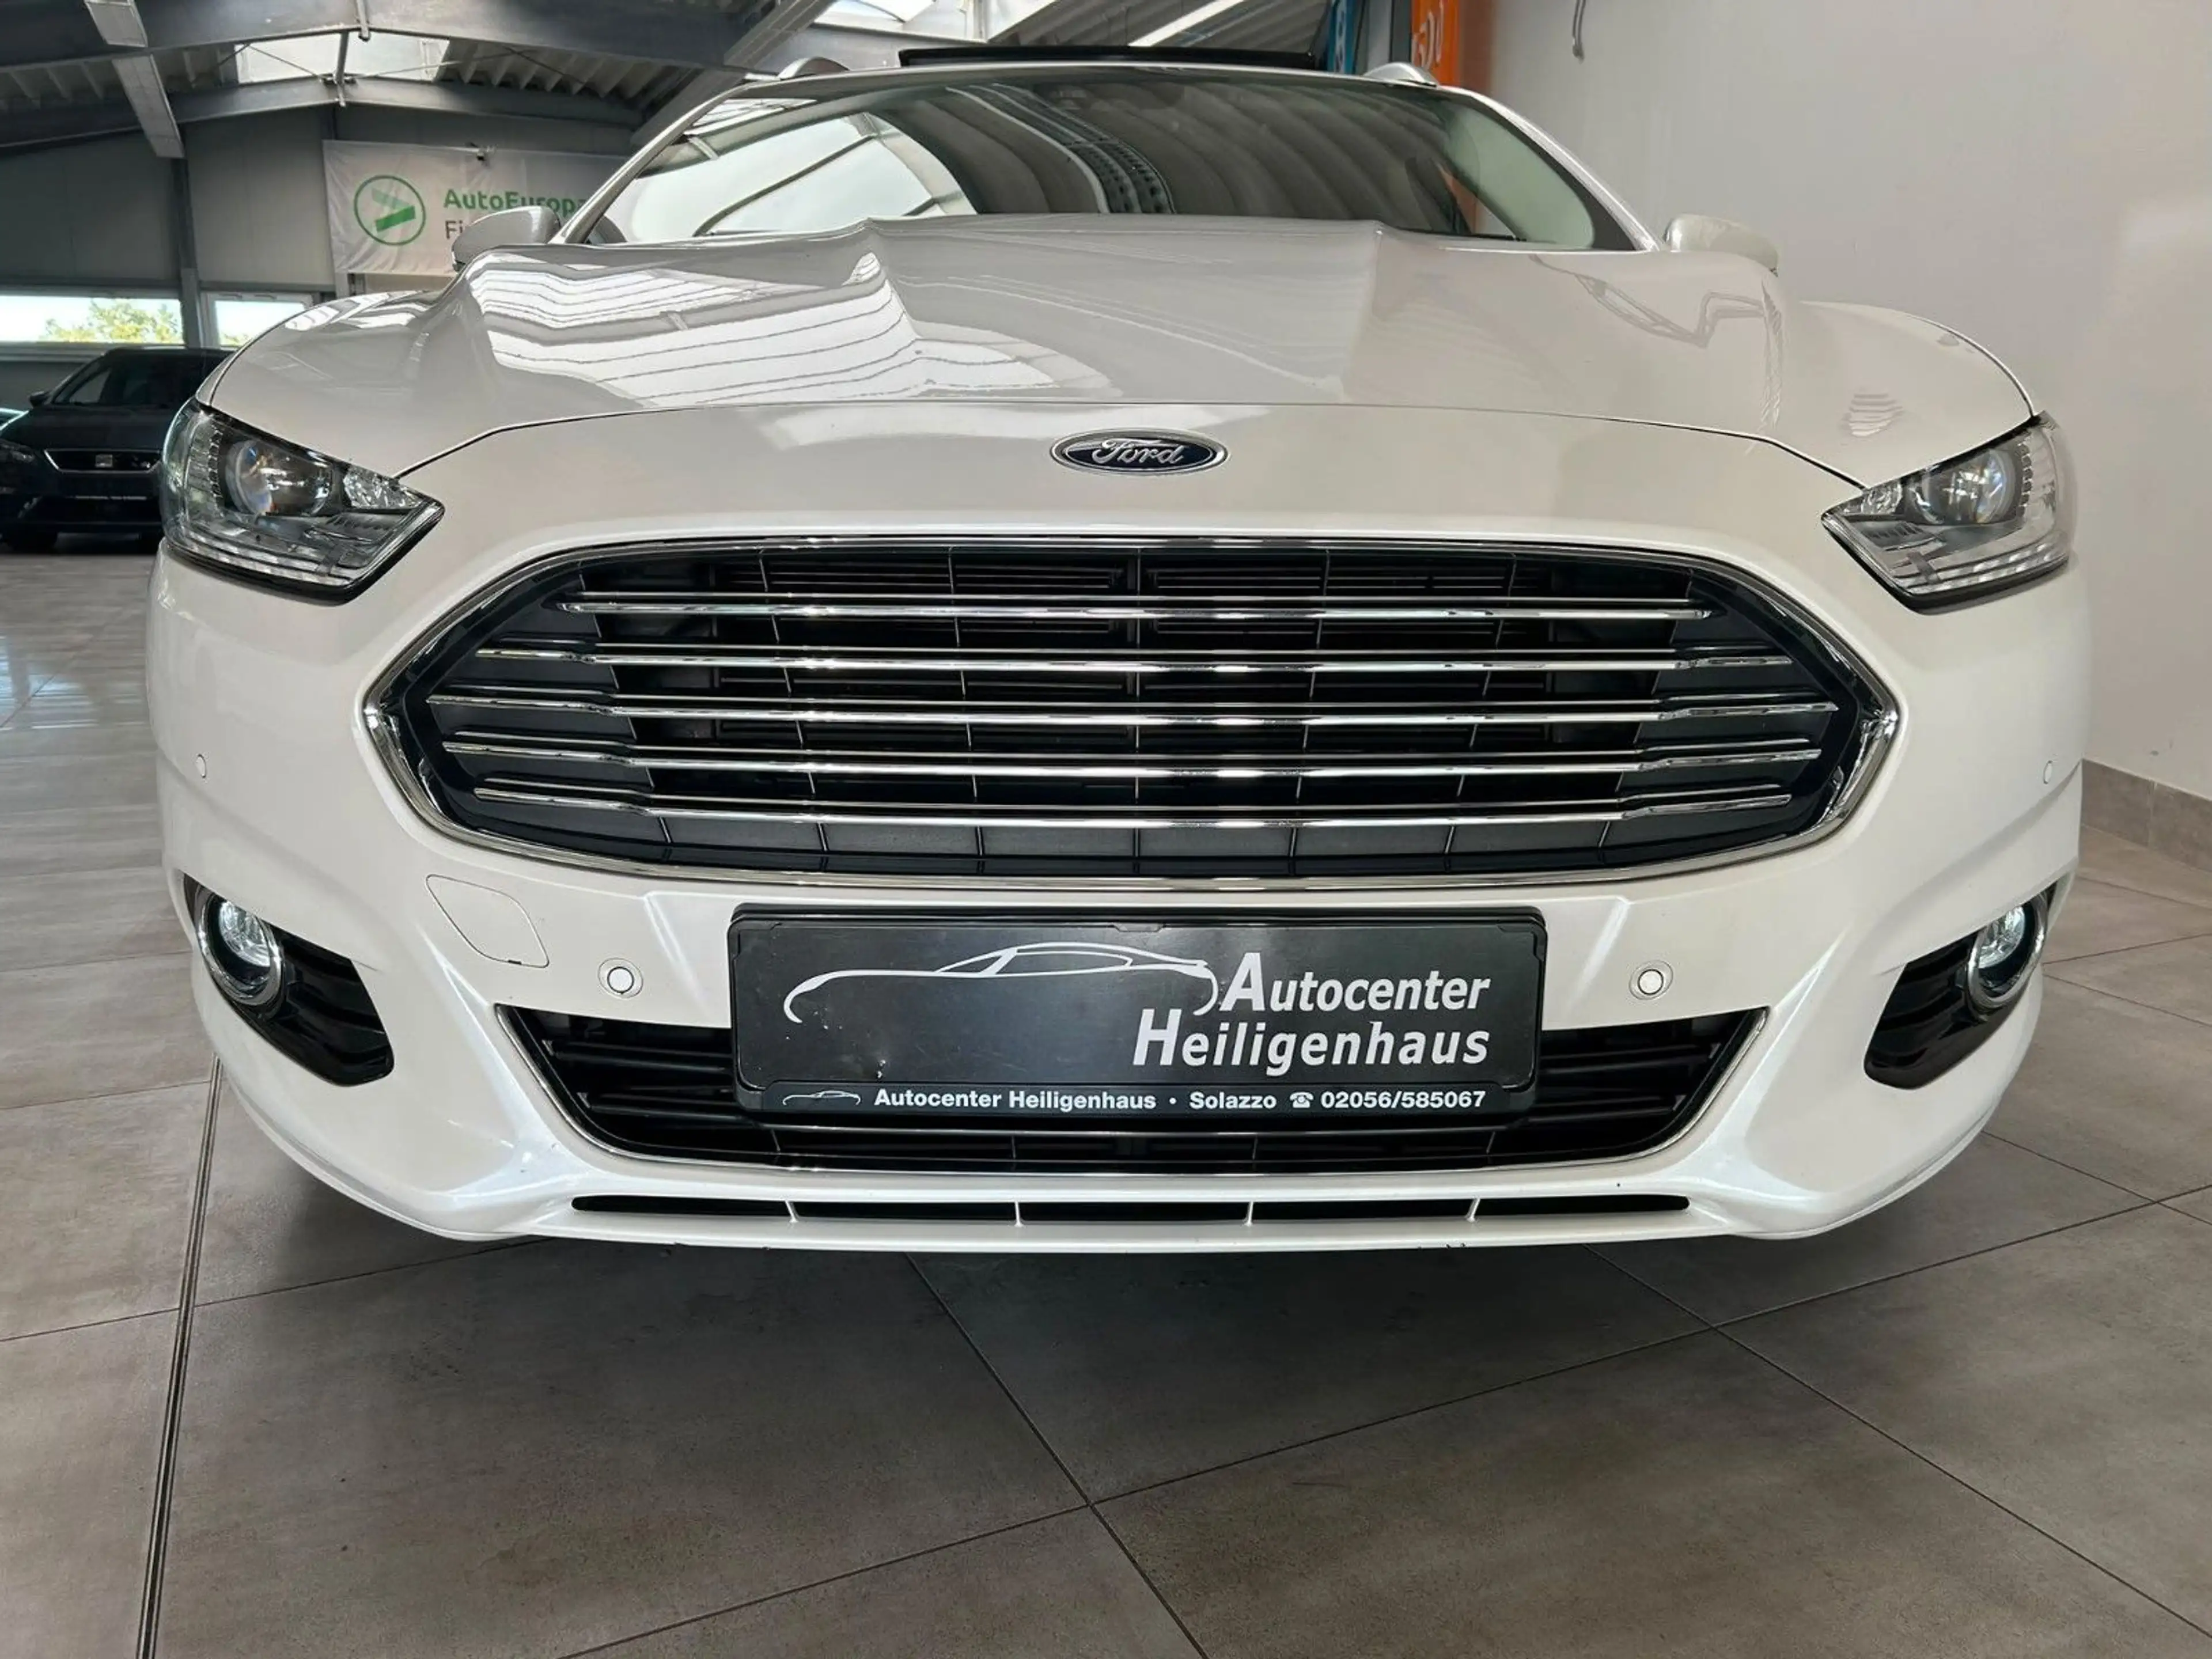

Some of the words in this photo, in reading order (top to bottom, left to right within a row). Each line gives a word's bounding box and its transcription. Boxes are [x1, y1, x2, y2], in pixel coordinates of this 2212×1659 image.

[1092, 437, 1185, 464] Ford
[1219, 952, 1491, 1012] Autocenter
[1132, 1008, 1490, 1076] Heiligenhaus
[873, 1088, 1002, 1108] Autocenter
[1009, 1090, 1157, 1112] Heiligenhaus
[1189, 1091, 1277, 1109] Solazzo
[1320, 1090, 1487, 1108] 02056/585067
